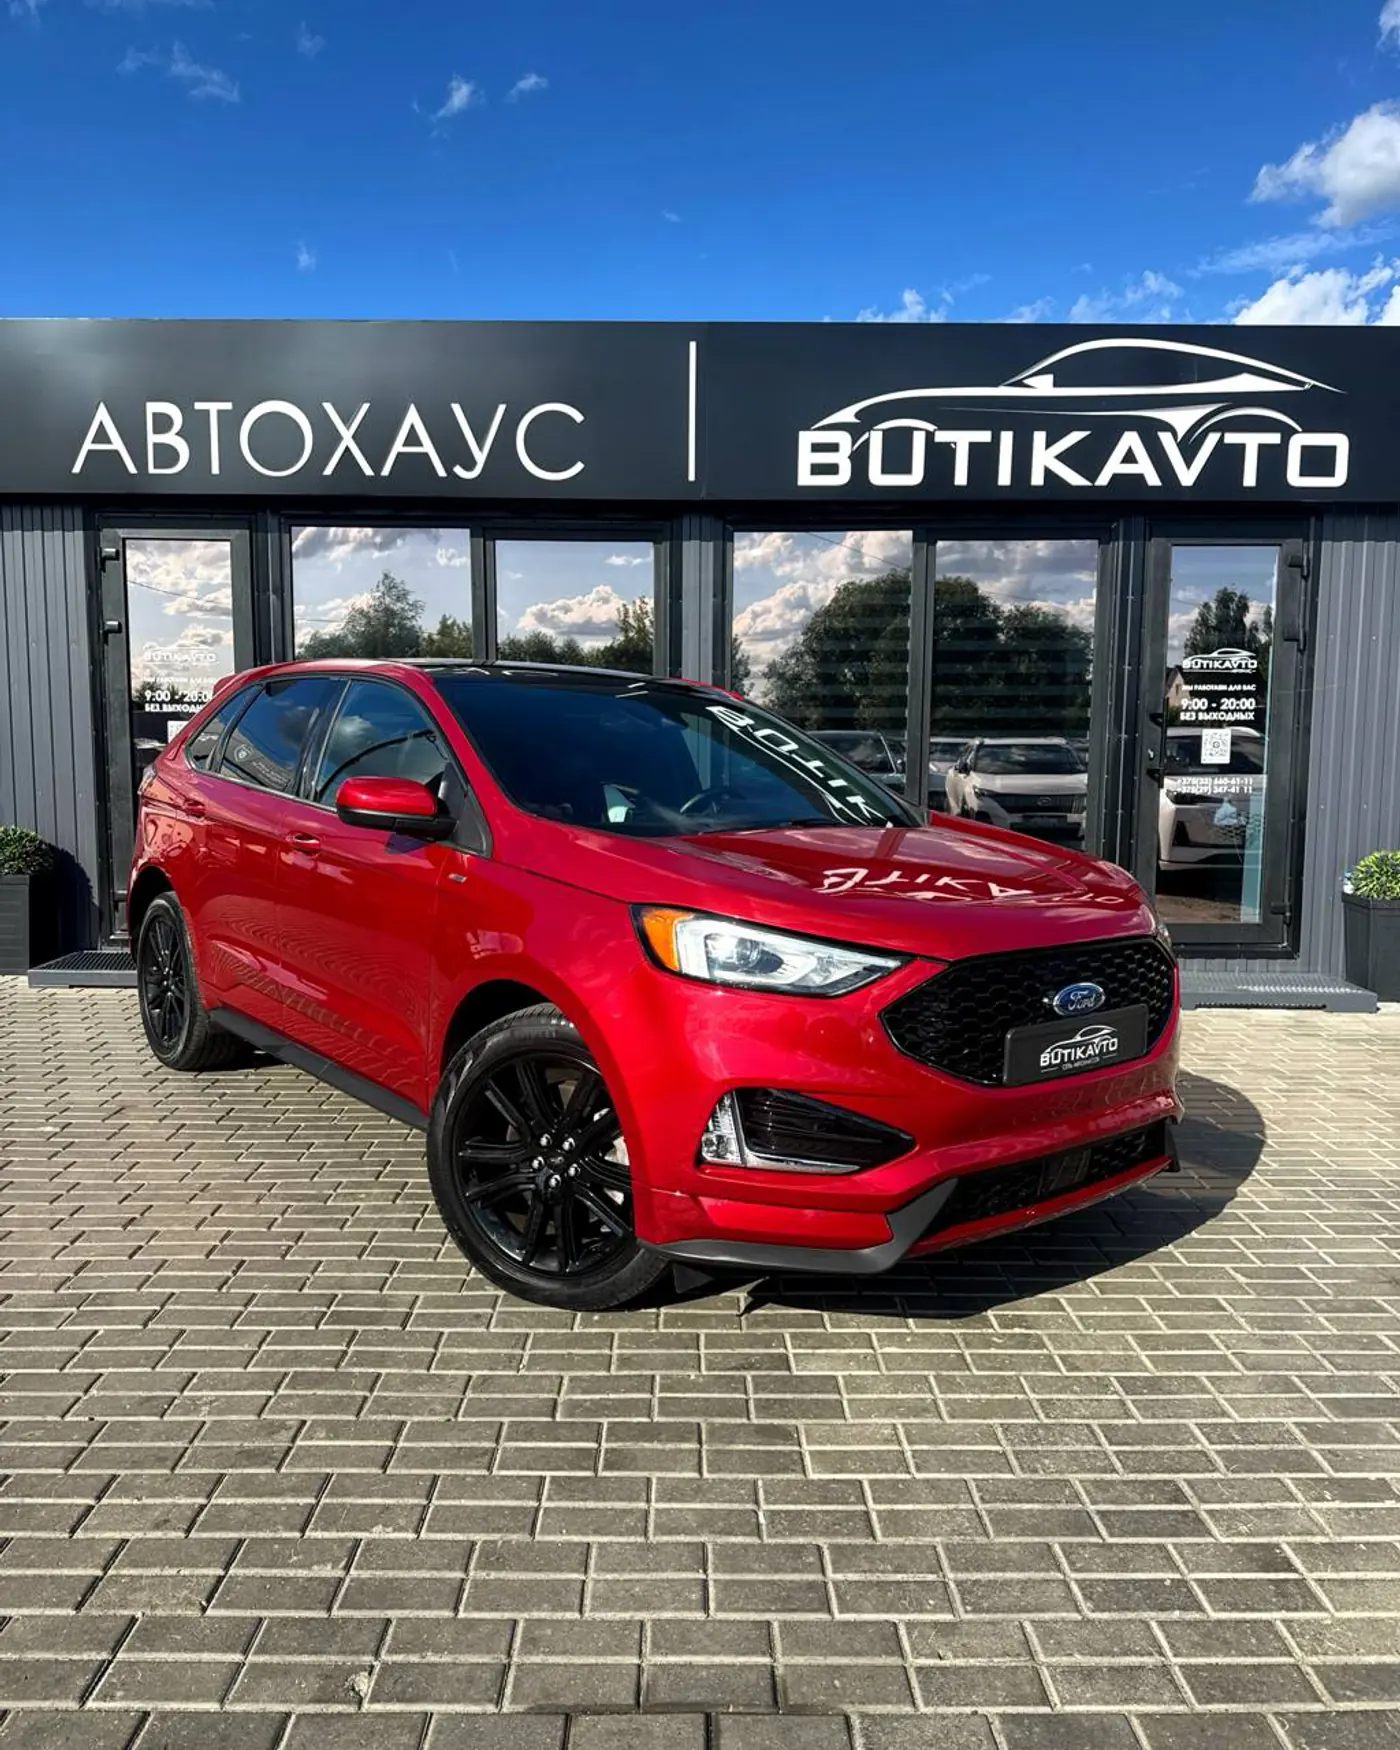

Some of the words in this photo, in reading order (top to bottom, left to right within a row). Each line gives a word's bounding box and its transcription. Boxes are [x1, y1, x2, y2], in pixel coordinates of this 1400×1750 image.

[72, 400, 586, 481] АВТОХАУС
[797, 430, 1350, 488] BUTIKAVTO
[1182, 660, 1258, 669] BUTIKAVTO
[145, 691, 171, 702] 9:00
[1181, 698, 1208, 710] 9:00
[1220, 698, 1256, 710] 20:00
[1180, 712, 1196, 721] БЕЗ
[1198, 712, 1255, 721] ВЫХОДНЫХ
[1067, 989, 1096, 1011] Ford
[1040, 1038, 1118, 1067] BUTIKAVTO
